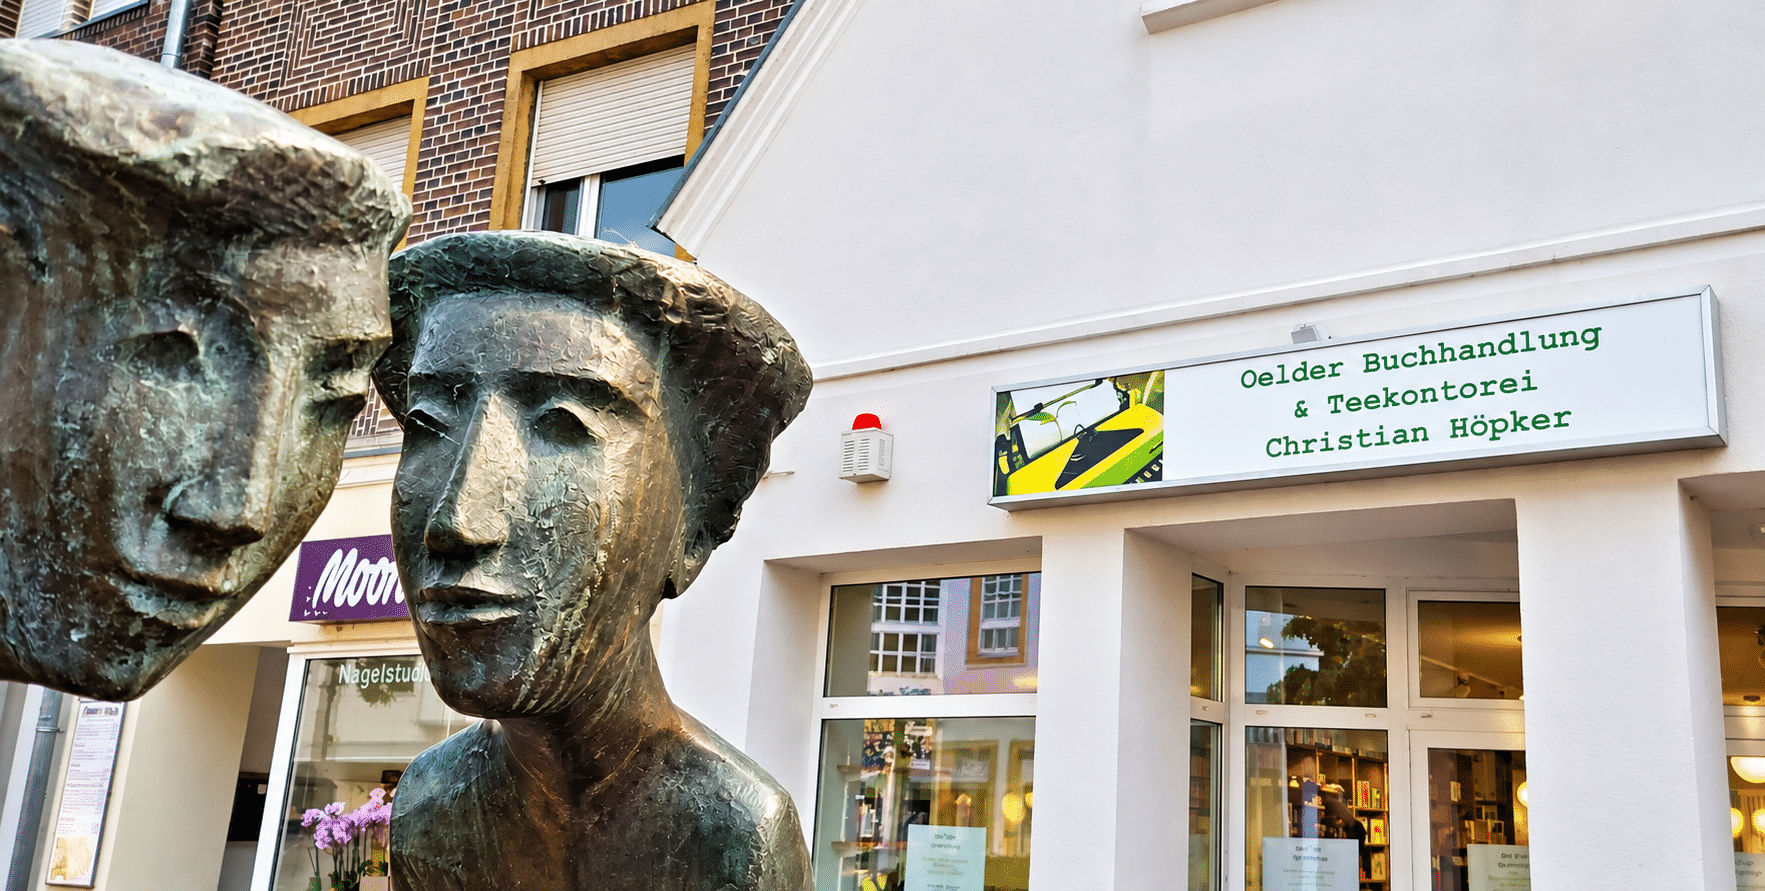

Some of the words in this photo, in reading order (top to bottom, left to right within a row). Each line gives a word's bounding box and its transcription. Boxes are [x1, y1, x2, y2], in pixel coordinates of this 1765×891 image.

[1240, 361, 1344, 389] Oelder
[1362, 326, 1603, 374] Buchhandlung
[1294, 400, 1309, 419] &
[1327, 369, 1538, 414] Teekontorei
[1265, 423, 1430, 458] Christian
[1449, 410, 1572, 442] Höpker
